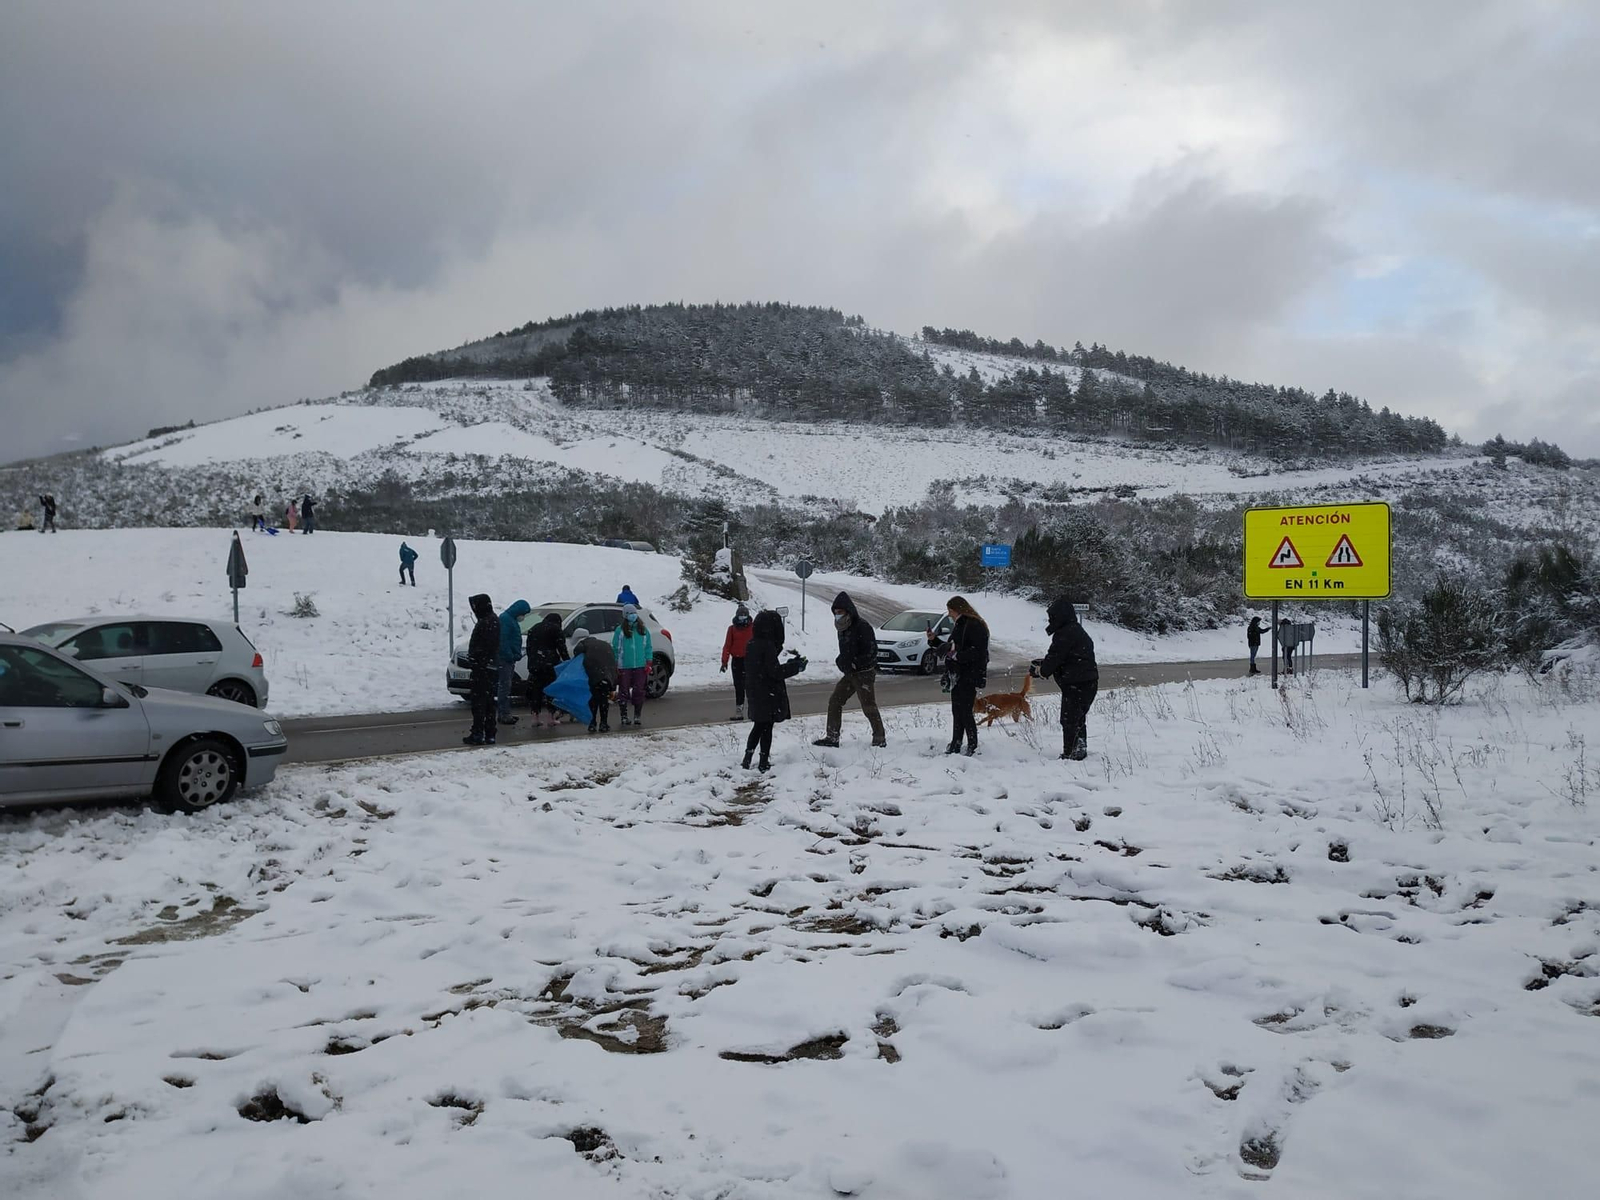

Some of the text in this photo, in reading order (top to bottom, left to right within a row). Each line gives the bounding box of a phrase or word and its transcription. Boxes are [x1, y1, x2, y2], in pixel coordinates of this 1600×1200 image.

[1280, 511, 1350, 526] ATENCIÓN
[1285, 579, 1344, 589] EN 11 Km
